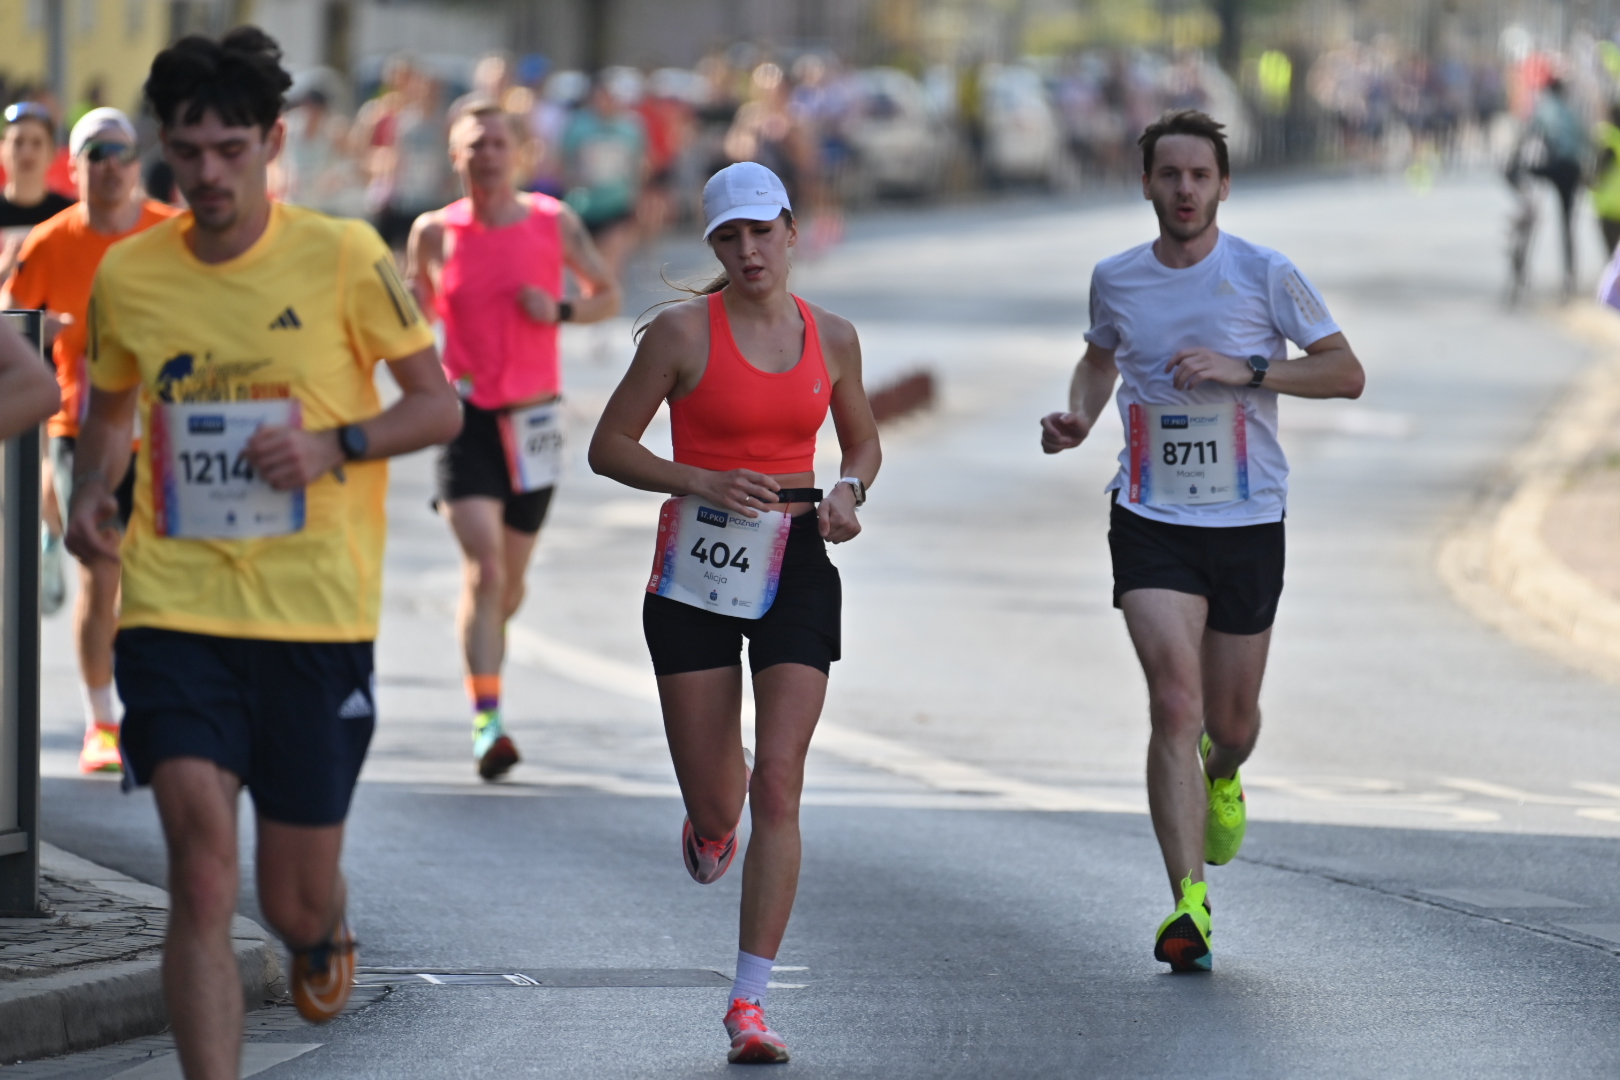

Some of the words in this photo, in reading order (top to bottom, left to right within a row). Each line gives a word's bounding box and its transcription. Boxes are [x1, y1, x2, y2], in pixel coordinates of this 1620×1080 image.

[1163, 440, 1218, 466] 8711
[1177, 470, 1204, 479] Maciej
[691, 538, 749, 573] 404
[704, 571, 728, 584] Alicja
